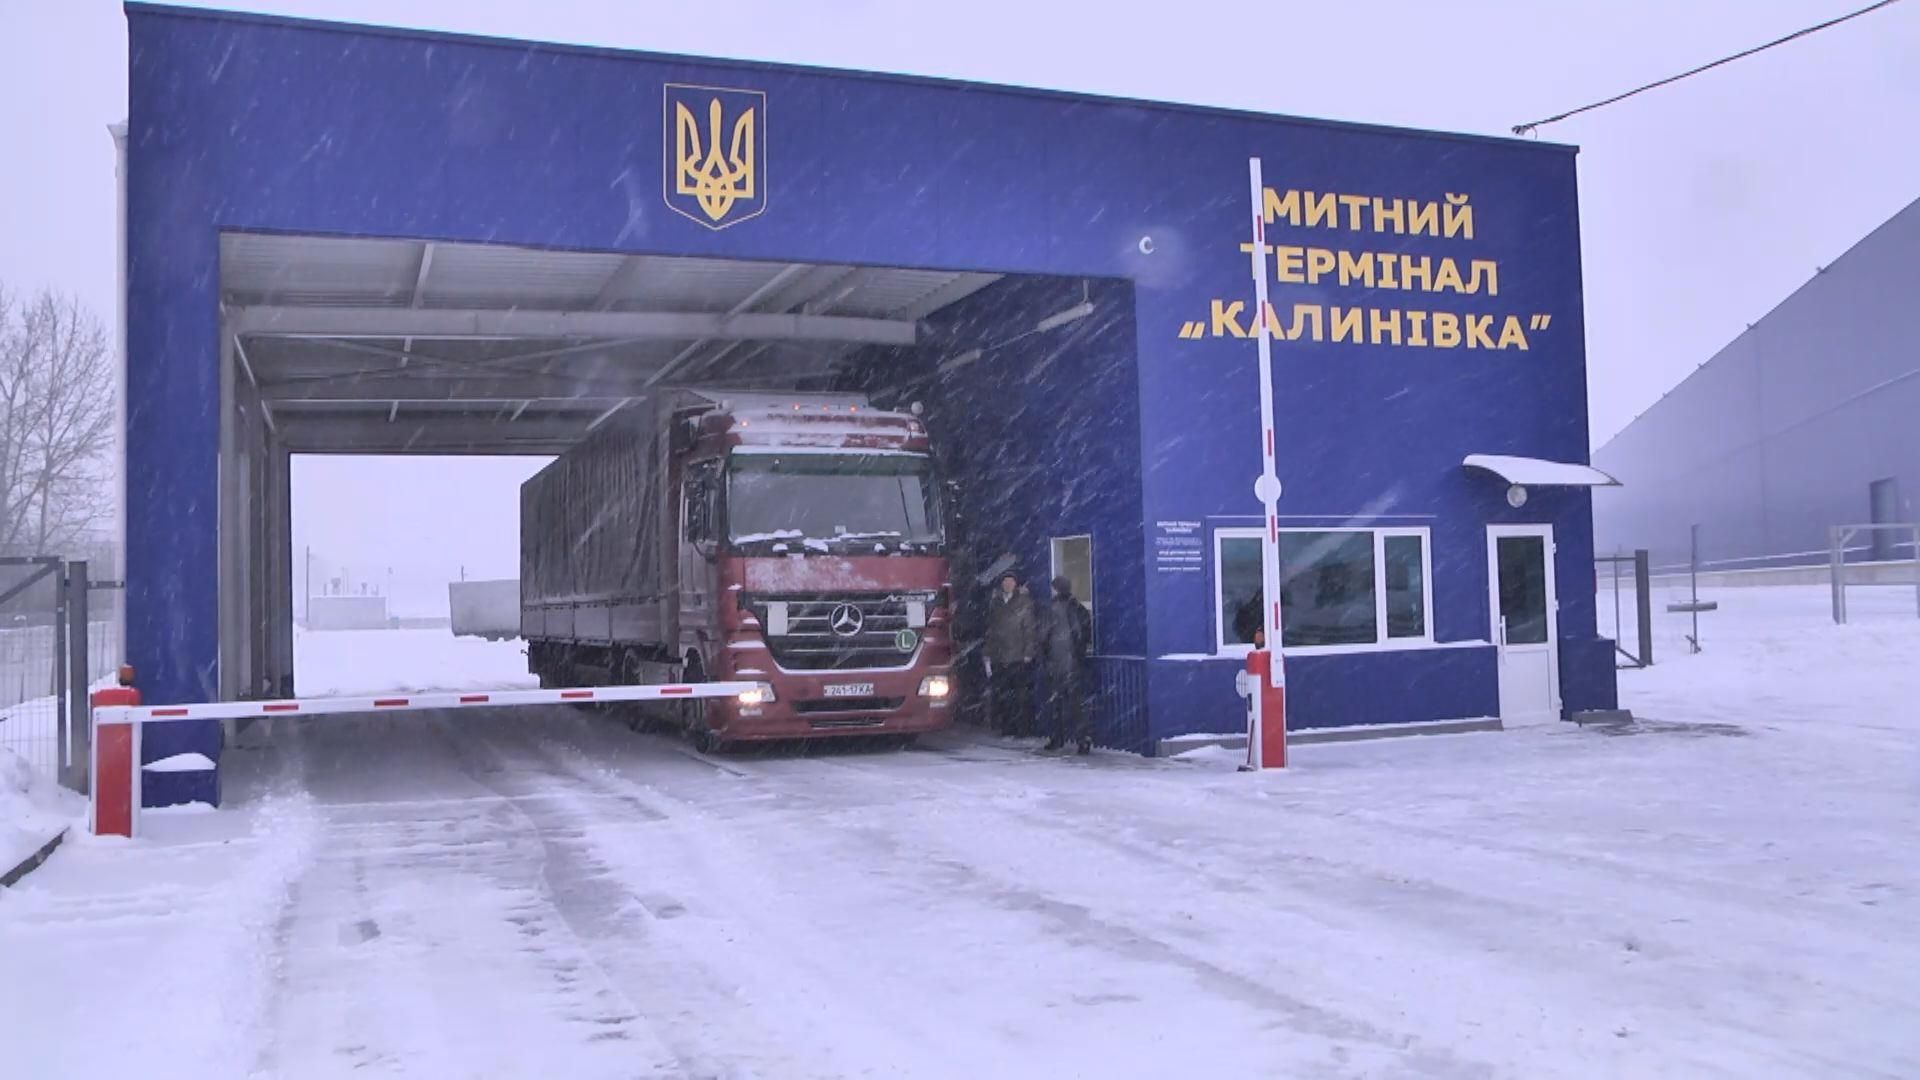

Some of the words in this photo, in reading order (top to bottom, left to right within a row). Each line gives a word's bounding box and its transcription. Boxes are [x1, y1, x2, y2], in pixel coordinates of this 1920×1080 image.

[1262, 187, 1474, 239] МИТНИЙ
[1240, 243, 1498, 296] ТЕРМІНАЛ
[902, 633, 910, 648] L
